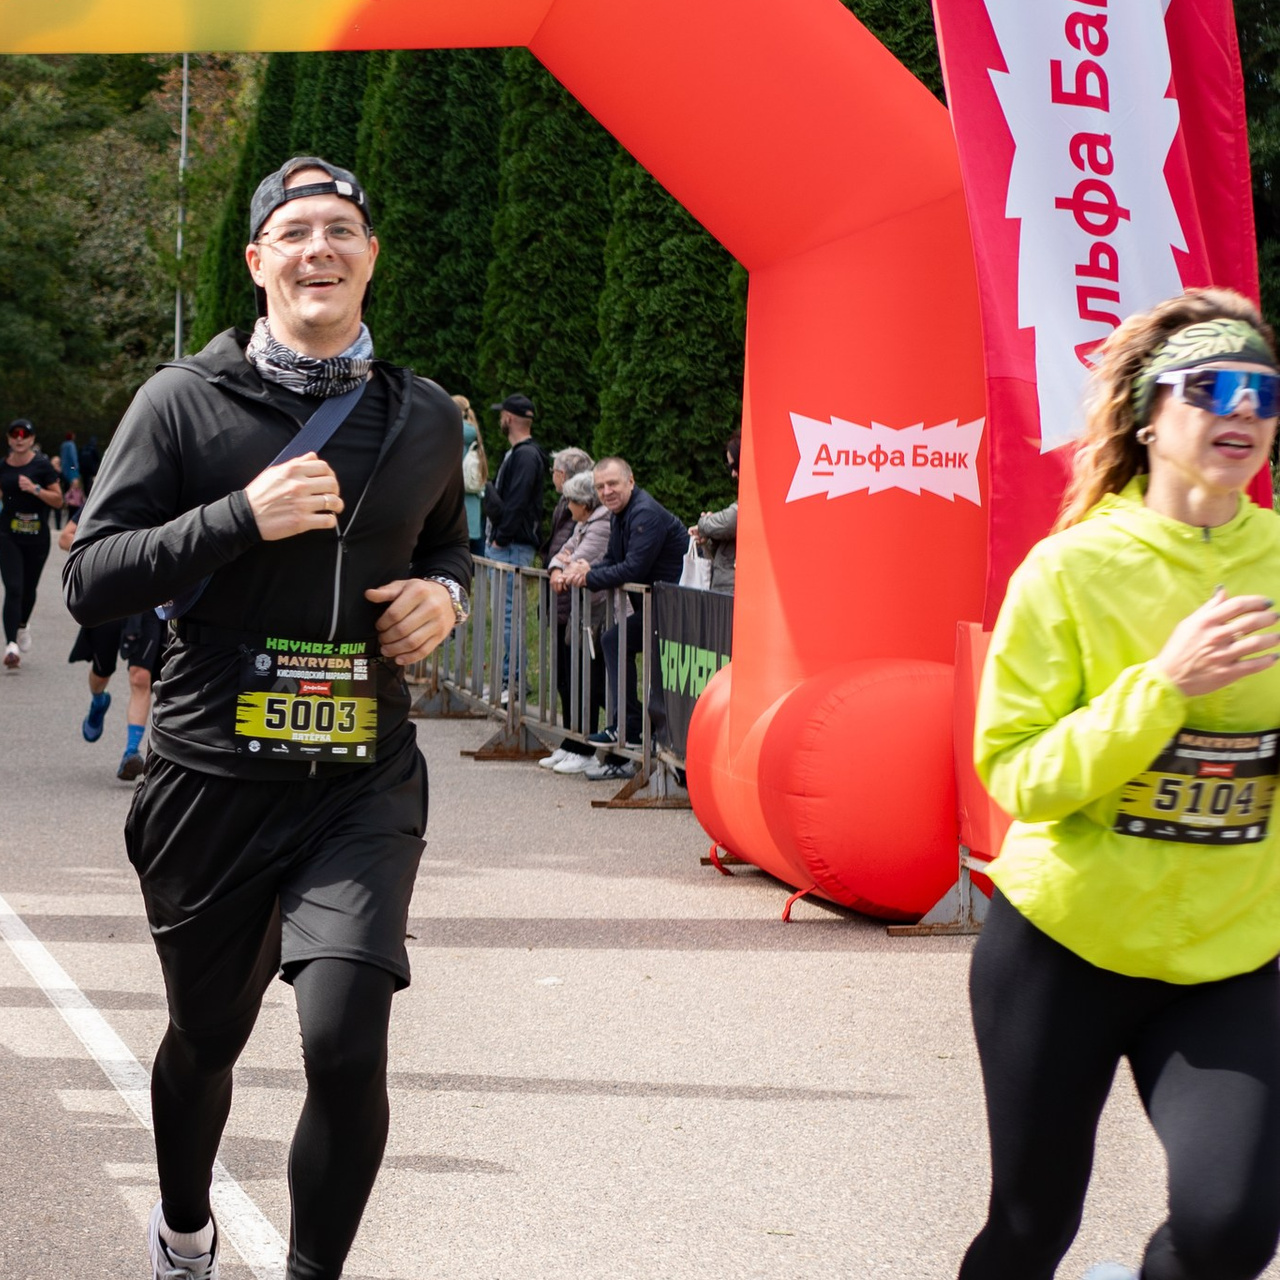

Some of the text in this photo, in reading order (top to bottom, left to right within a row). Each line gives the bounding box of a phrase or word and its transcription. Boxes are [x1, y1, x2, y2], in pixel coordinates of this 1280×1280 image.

[813, 443, 969, 473] Альфа Банк
[277, 655, 352, 669] MAYRVEDA
[264, 697, 358, 734] 5003
[1152, 777, 1257, 816] 5104
